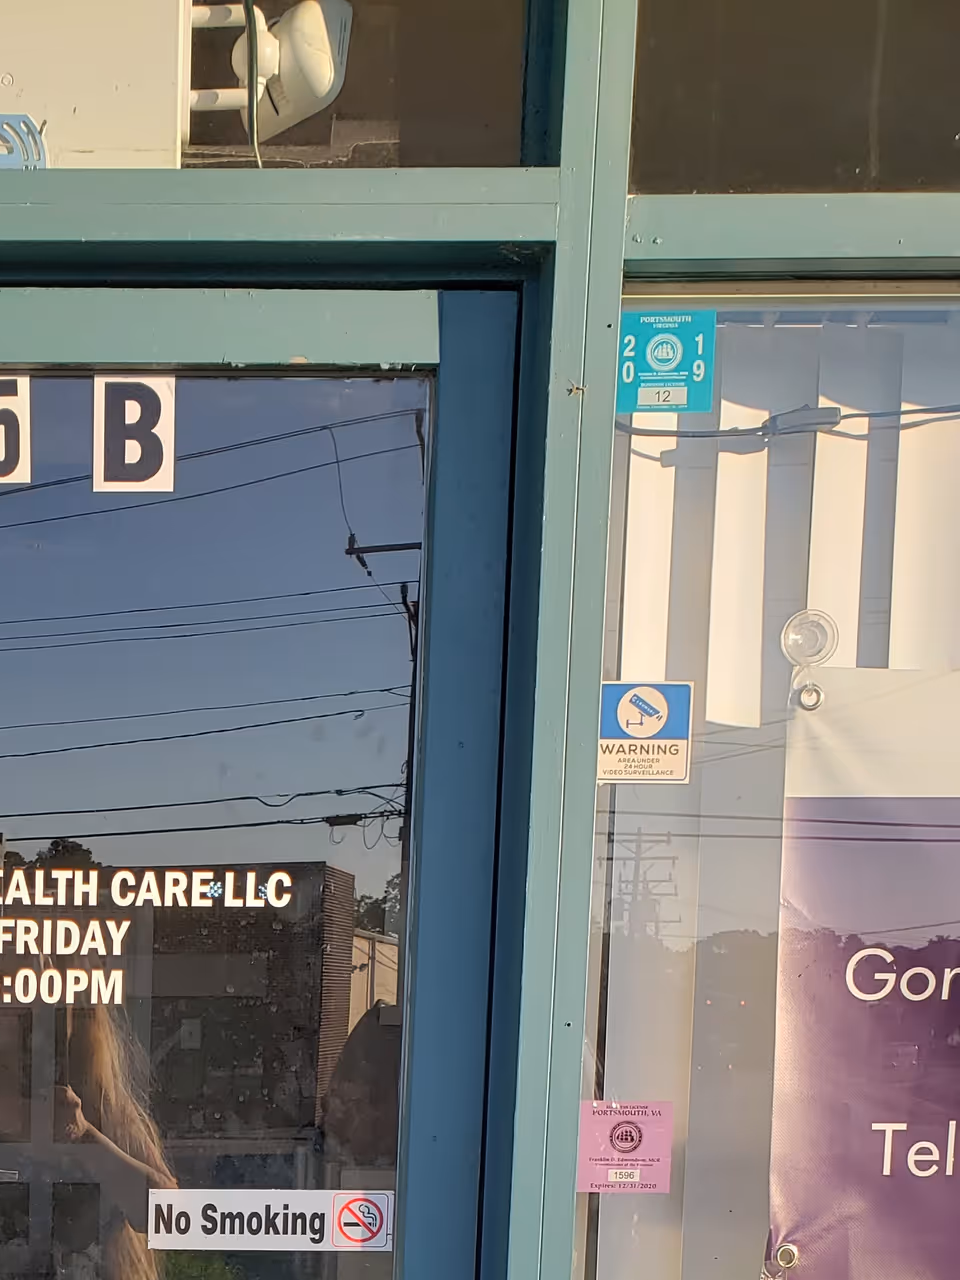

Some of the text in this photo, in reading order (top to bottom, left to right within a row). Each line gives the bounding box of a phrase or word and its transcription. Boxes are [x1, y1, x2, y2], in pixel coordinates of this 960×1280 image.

[640, 315, 692, 324] PORTSMOUTH
[654, 390, 671, 403] 12
[103, 381, 164, 483] B
[600, 743, 680, 756] WARNING
[110, 870, 214, 908] CARE
[224, 871, 293, 909] LLC
[651, 1109, 662, 1117] VA
[871, 1120, 957, 1177] Tel
[613, 1171, 635, 1180] 1596
[590, 1182, 616, 1190] Expires:
[154, 1202, 326, 1245] No Smoking
